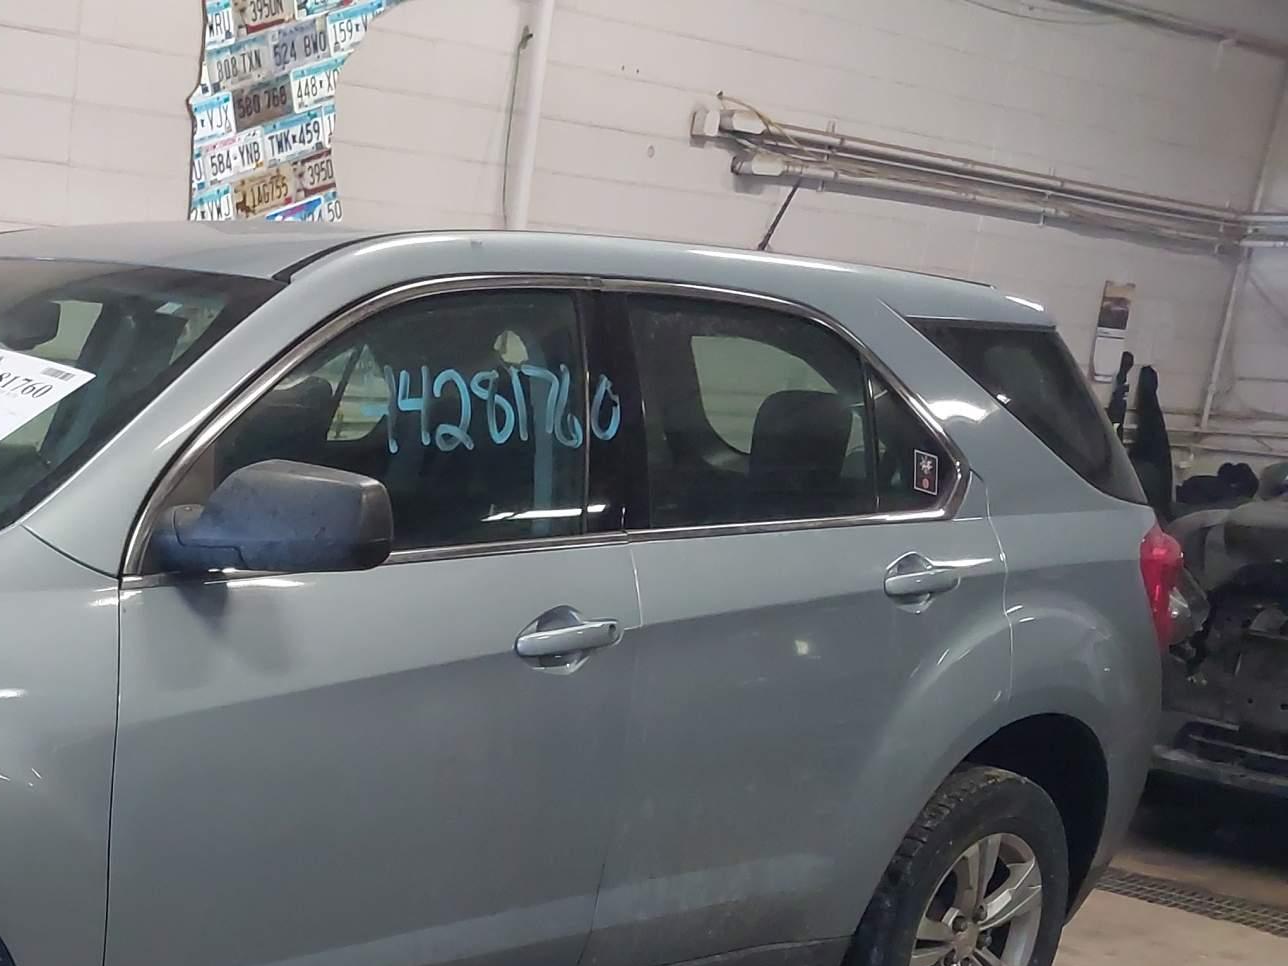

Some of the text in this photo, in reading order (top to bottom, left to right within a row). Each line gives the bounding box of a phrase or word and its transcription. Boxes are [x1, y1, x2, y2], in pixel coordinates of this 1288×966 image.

[332, 20, 353, 43] 159
[273, 41, 296, 67] 524
[297, 76, 318, 99] 448
[298, 120, 320, 146] 459
